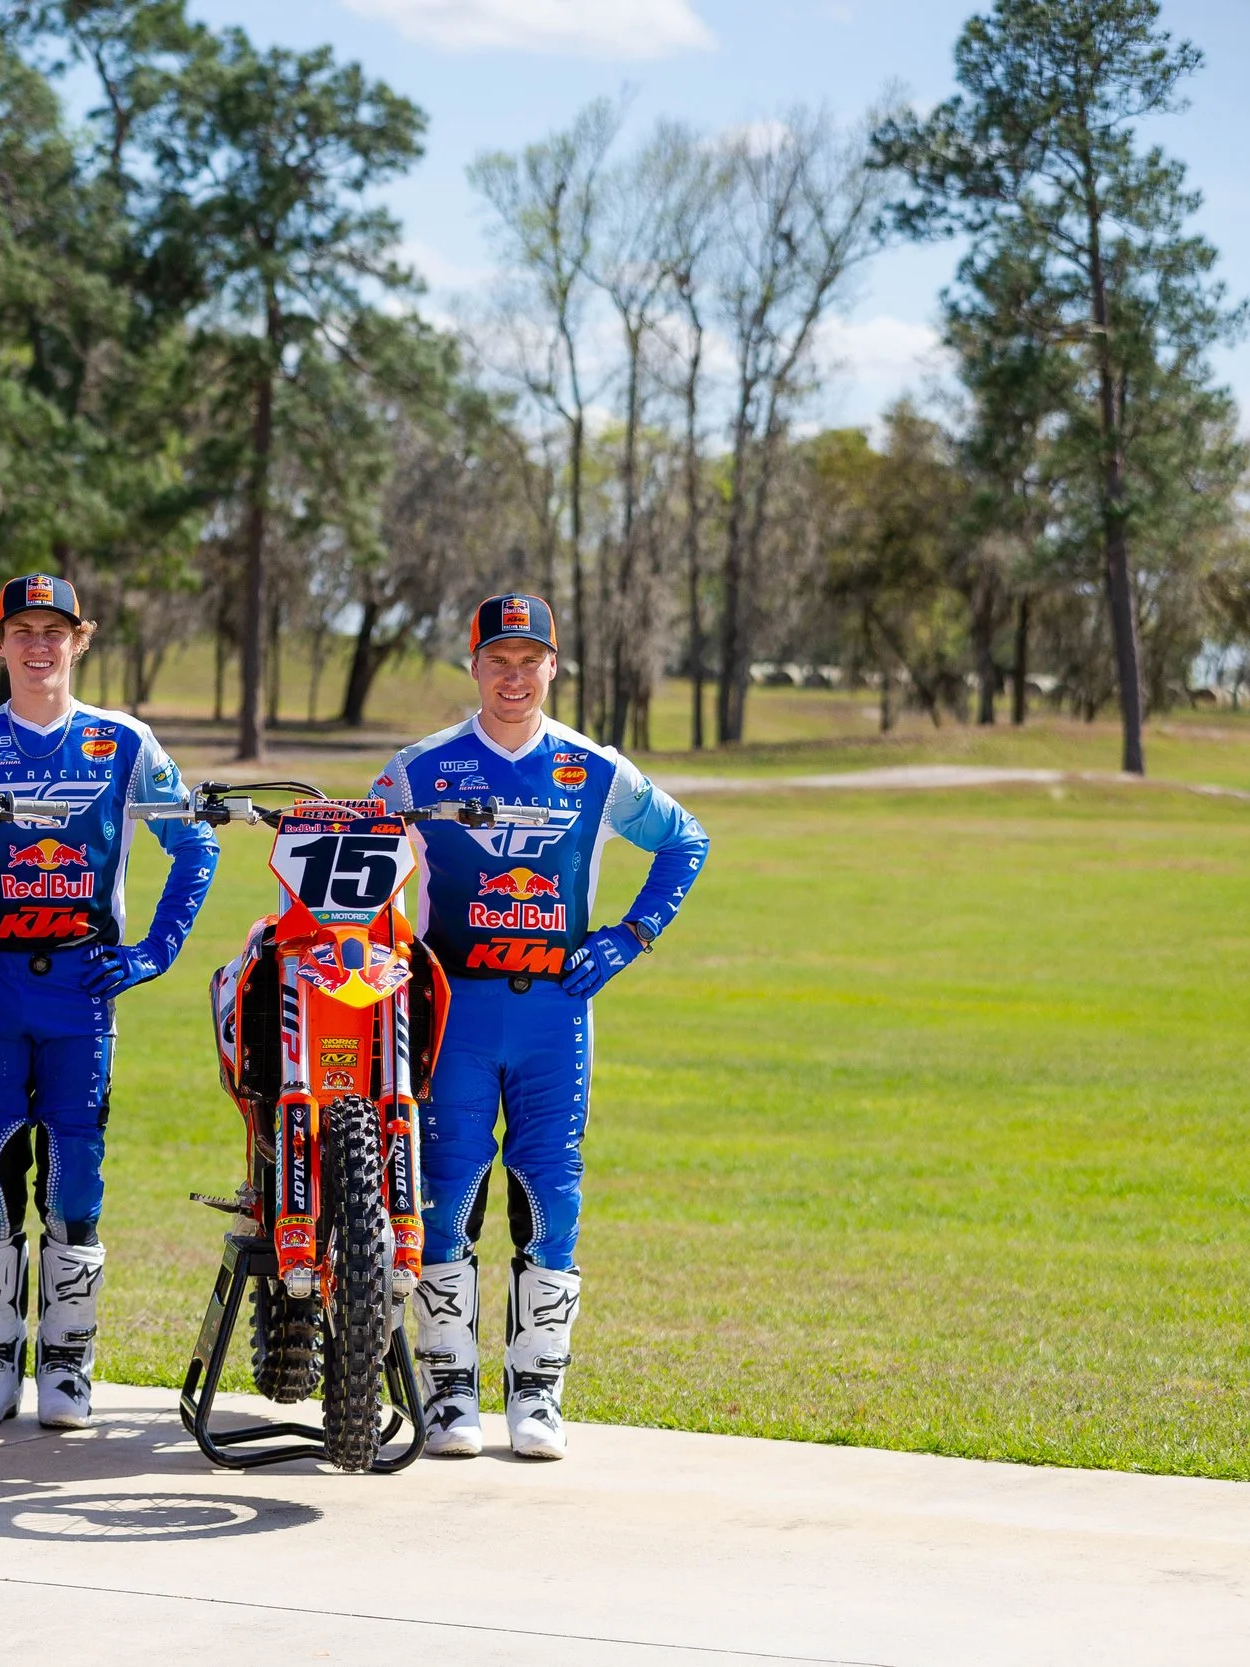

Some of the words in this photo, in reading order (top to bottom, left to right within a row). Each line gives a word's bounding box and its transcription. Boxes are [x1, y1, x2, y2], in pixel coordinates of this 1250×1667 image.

[82, 727, 116, 737] MRC
[440, 760, 478, 773] WPS
[554, 753, 587, 763] MRC
[27, 769, 112, 779] RACING
[497, 796, 582, 809] RACING
[285, 824, 304, 833] Red
[304, 824, 321, 833] Bull
[371, 824, 401, 834] KTM
[0, 872, 48, 899] Red
[50, 871, 95, 899] Bull
[290, 836, 400, 909] 15
[331, 913, 369, 921] MOTOREX
[469, 902, 520, 929] Red
[522, 903, 566, 932] Bull
[466, 937, 565, 974] KTM
[597, 938, 625, 968] FLY
[572, 1016, 584, 1101] RACING
[88, 1072, 100, 1108] FLY
[566, 1113, 579, 1149] FLY
[293, 1123, 305, 1210] DNLOP
[277, 1217, 313, 1227] ACERBIS
